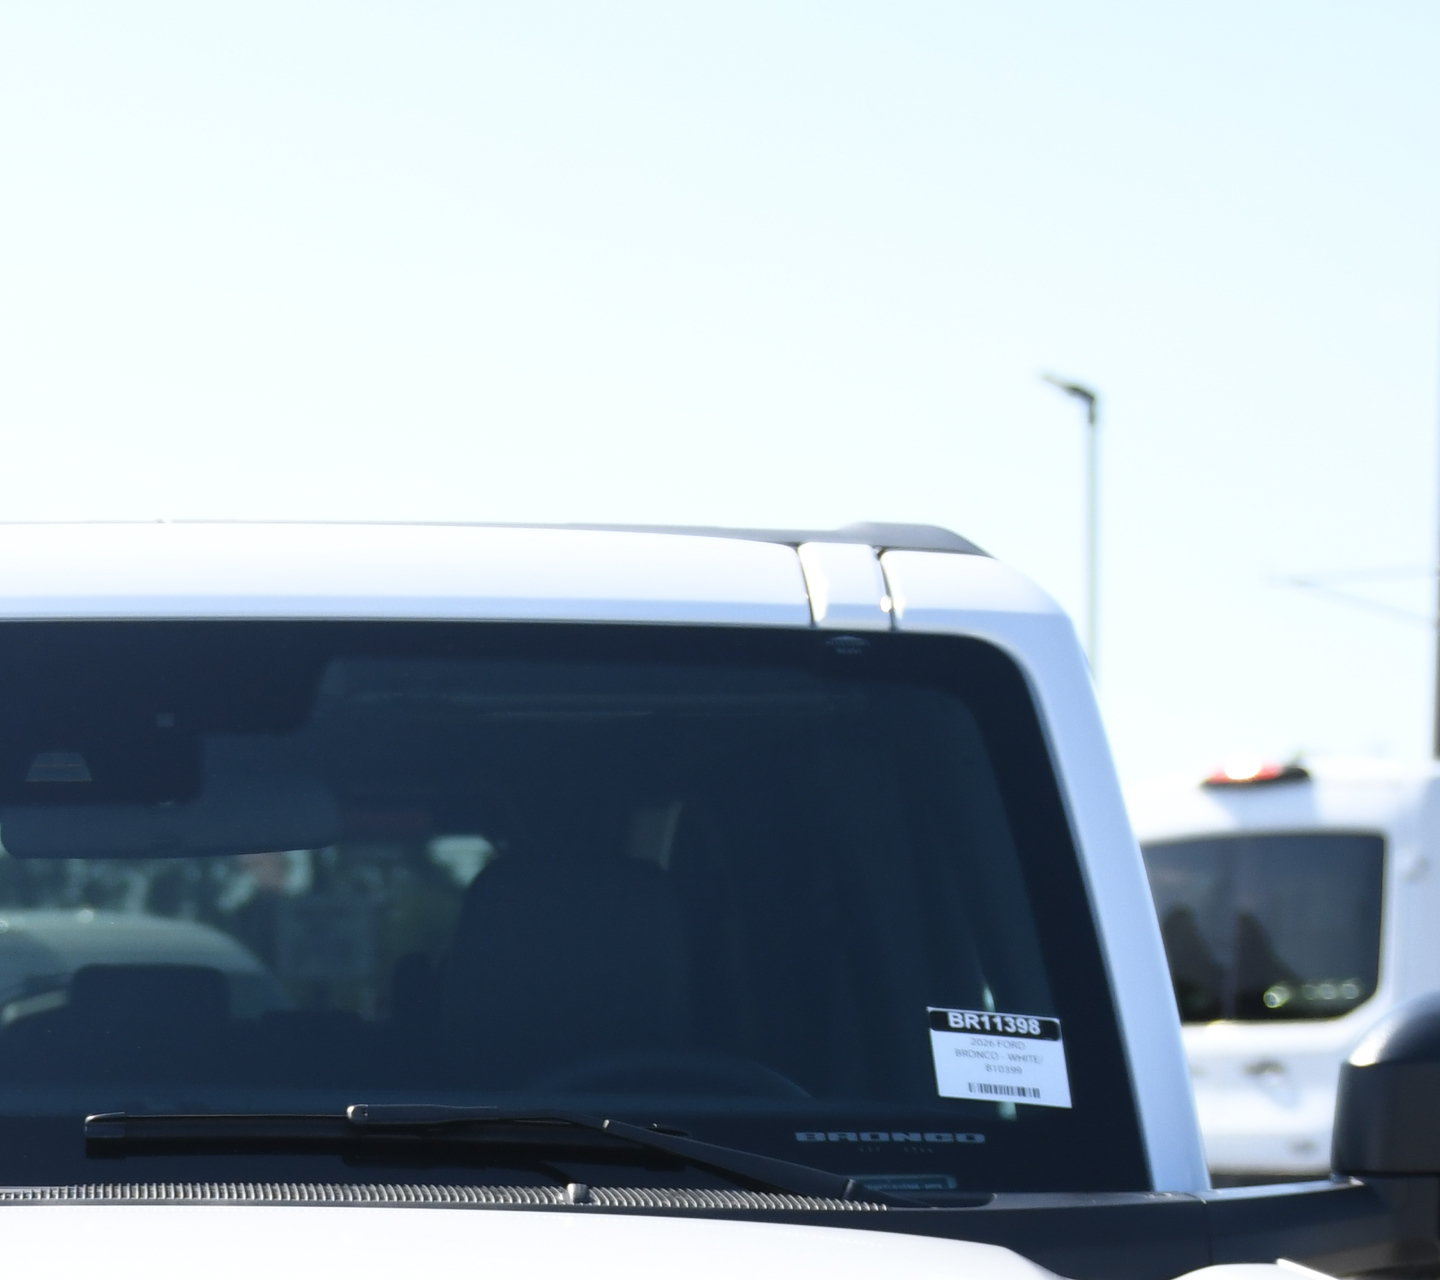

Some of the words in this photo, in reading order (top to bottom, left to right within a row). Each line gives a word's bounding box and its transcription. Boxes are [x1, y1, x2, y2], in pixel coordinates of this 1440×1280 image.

[949, 1012, 1041, 1035] BR11398
[970, 1037, 995, 1048] 2026
[996, 1039, 1026, 1050] FORD
[954, 1048, 1000, 1060] BRONCO
[795, 1132, 985, 1143] BRONCO
